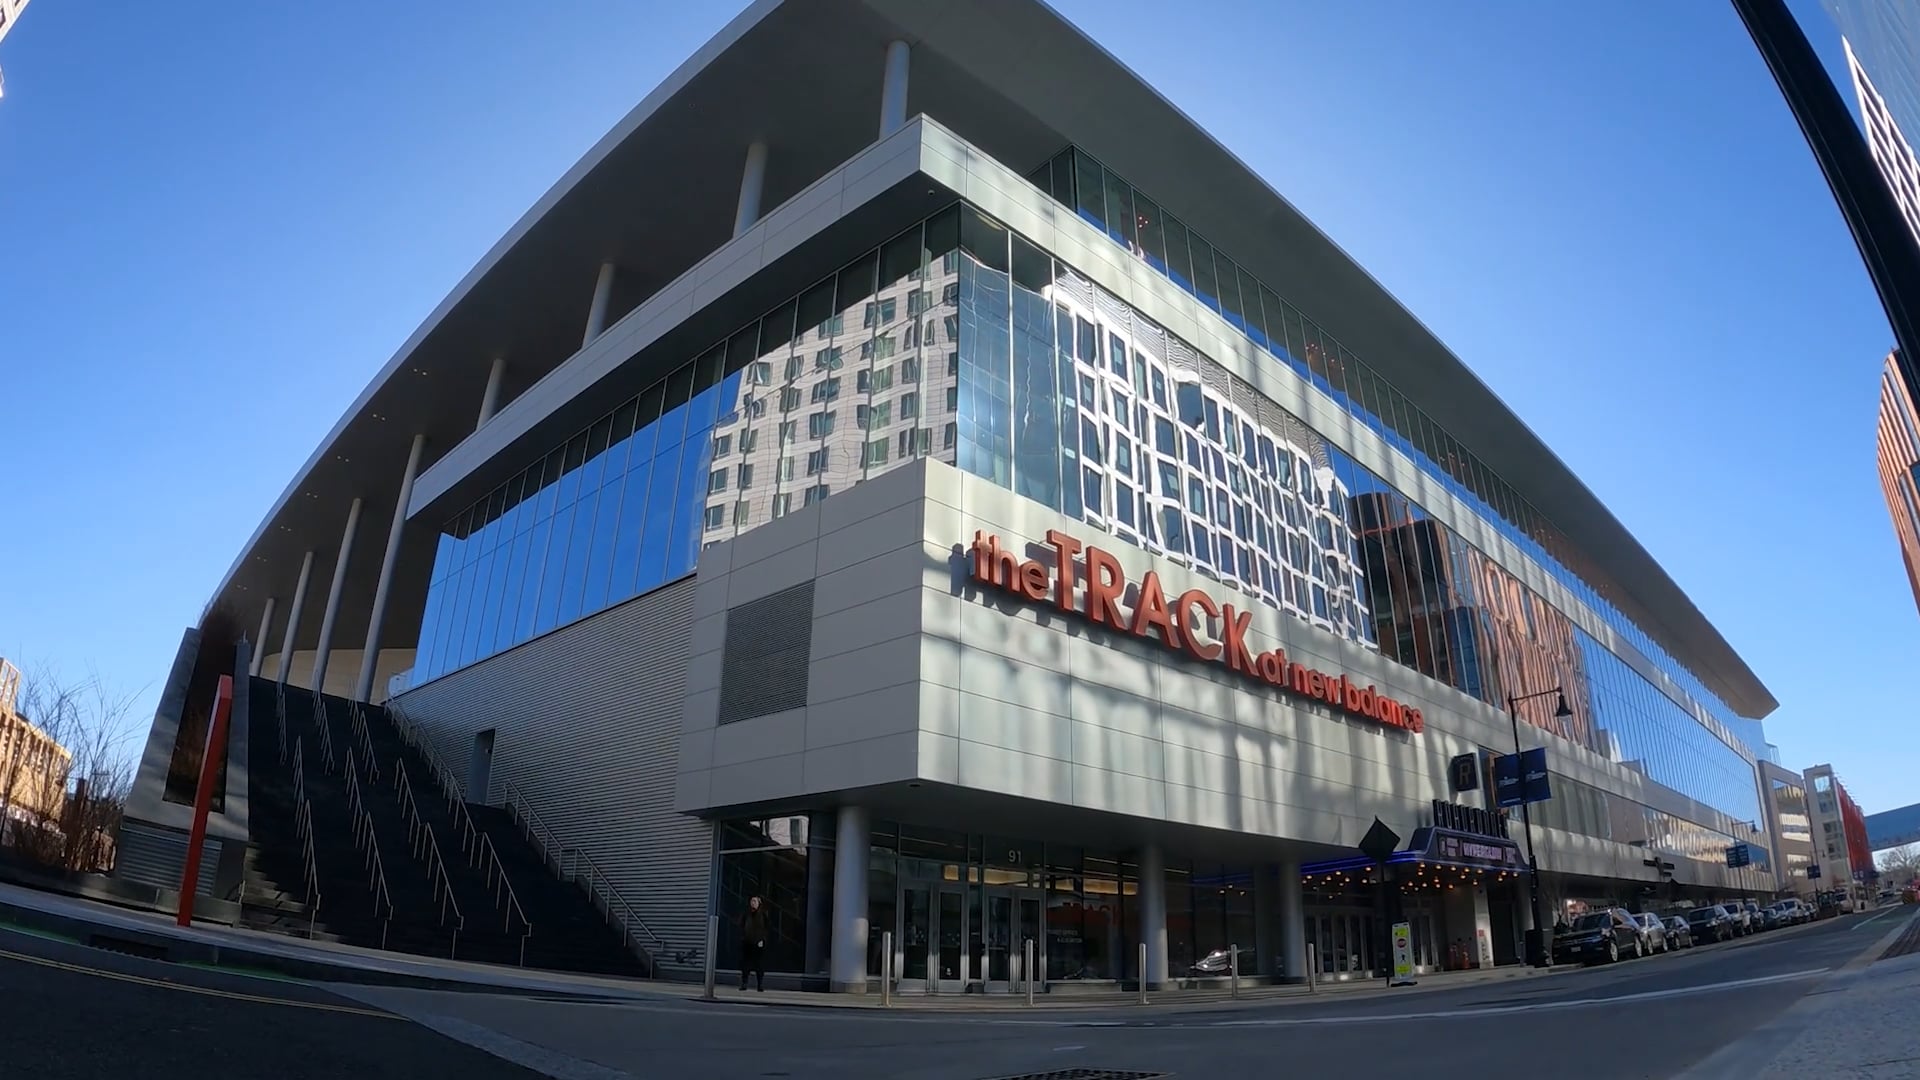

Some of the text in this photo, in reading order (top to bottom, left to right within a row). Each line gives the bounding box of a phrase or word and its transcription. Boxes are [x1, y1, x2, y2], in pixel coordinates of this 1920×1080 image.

[972, 528, 1425, 733] the TRACK at new balance
[1008, 850, 1021, 862] 91
